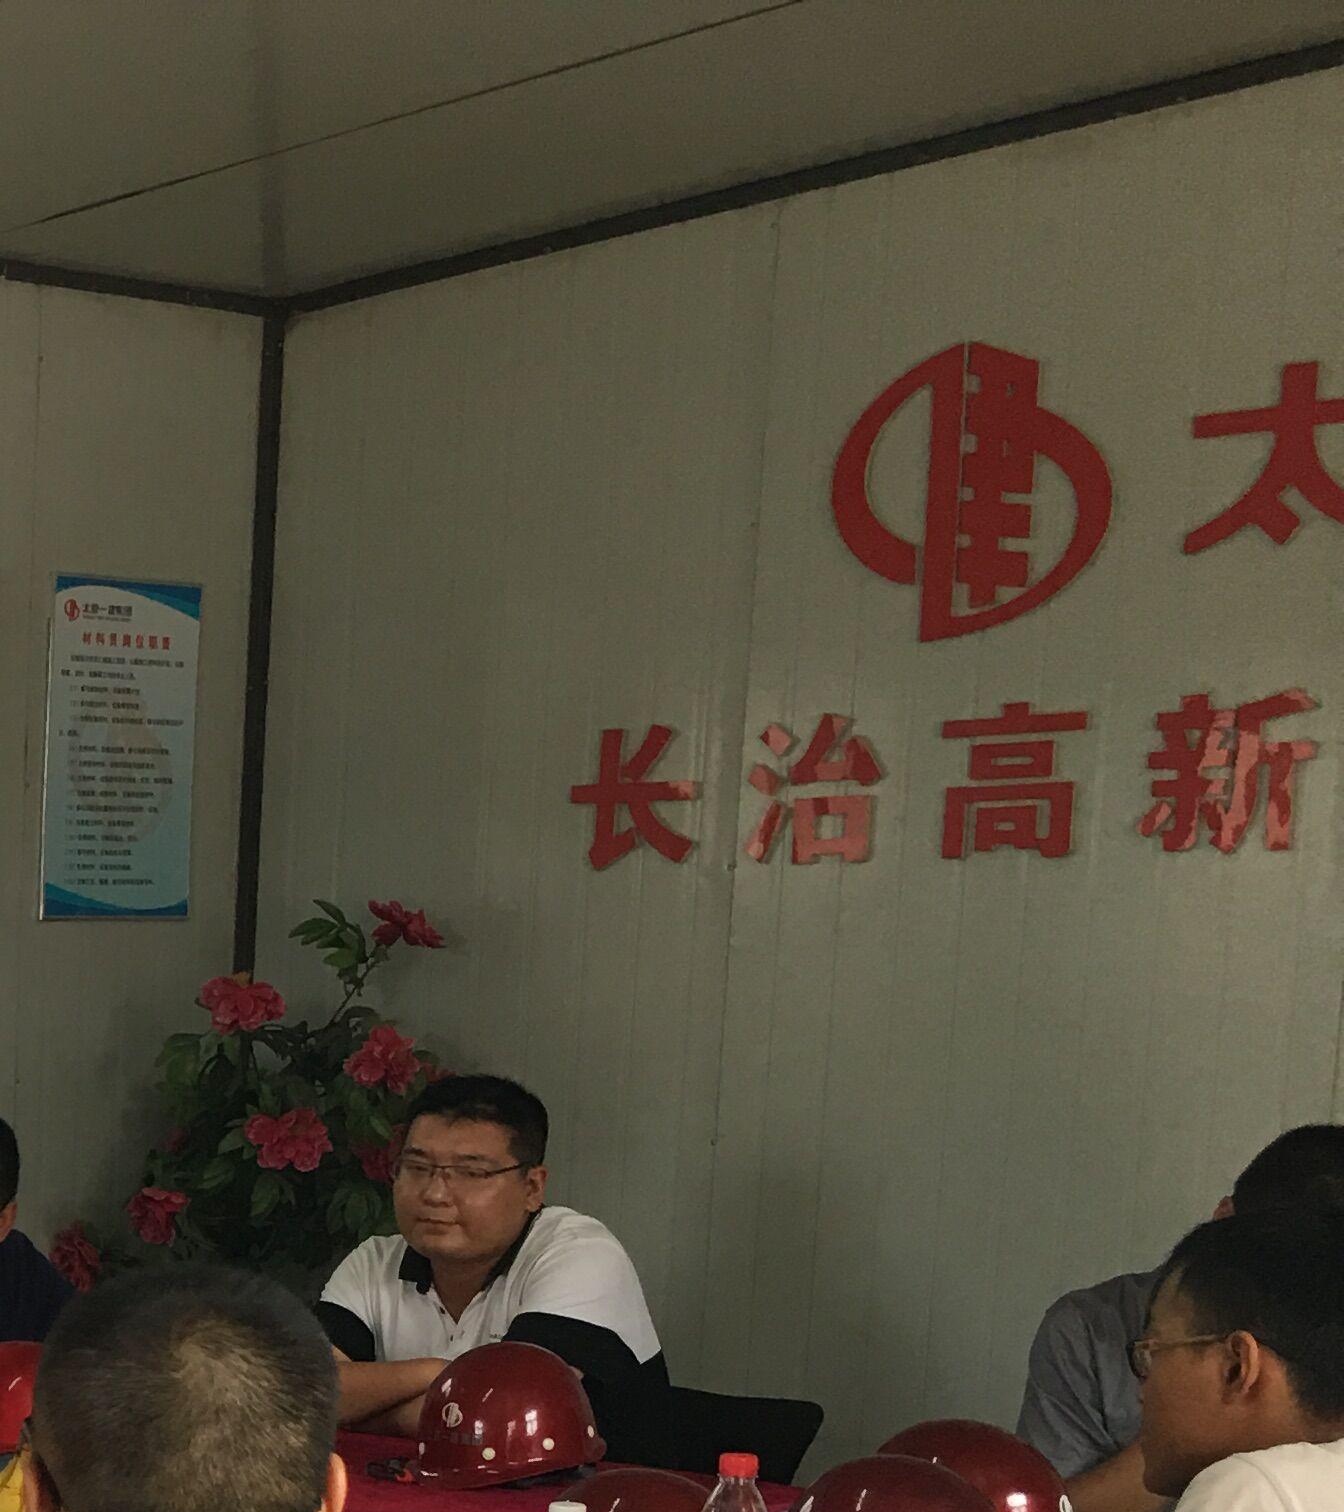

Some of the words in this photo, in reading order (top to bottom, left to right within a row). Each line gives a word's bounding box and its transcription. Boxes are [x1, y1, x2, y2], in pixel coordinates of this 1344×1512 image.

[1183, 360, 1344, 554] 太
[570, 687, 1319, 871] 长治高新
